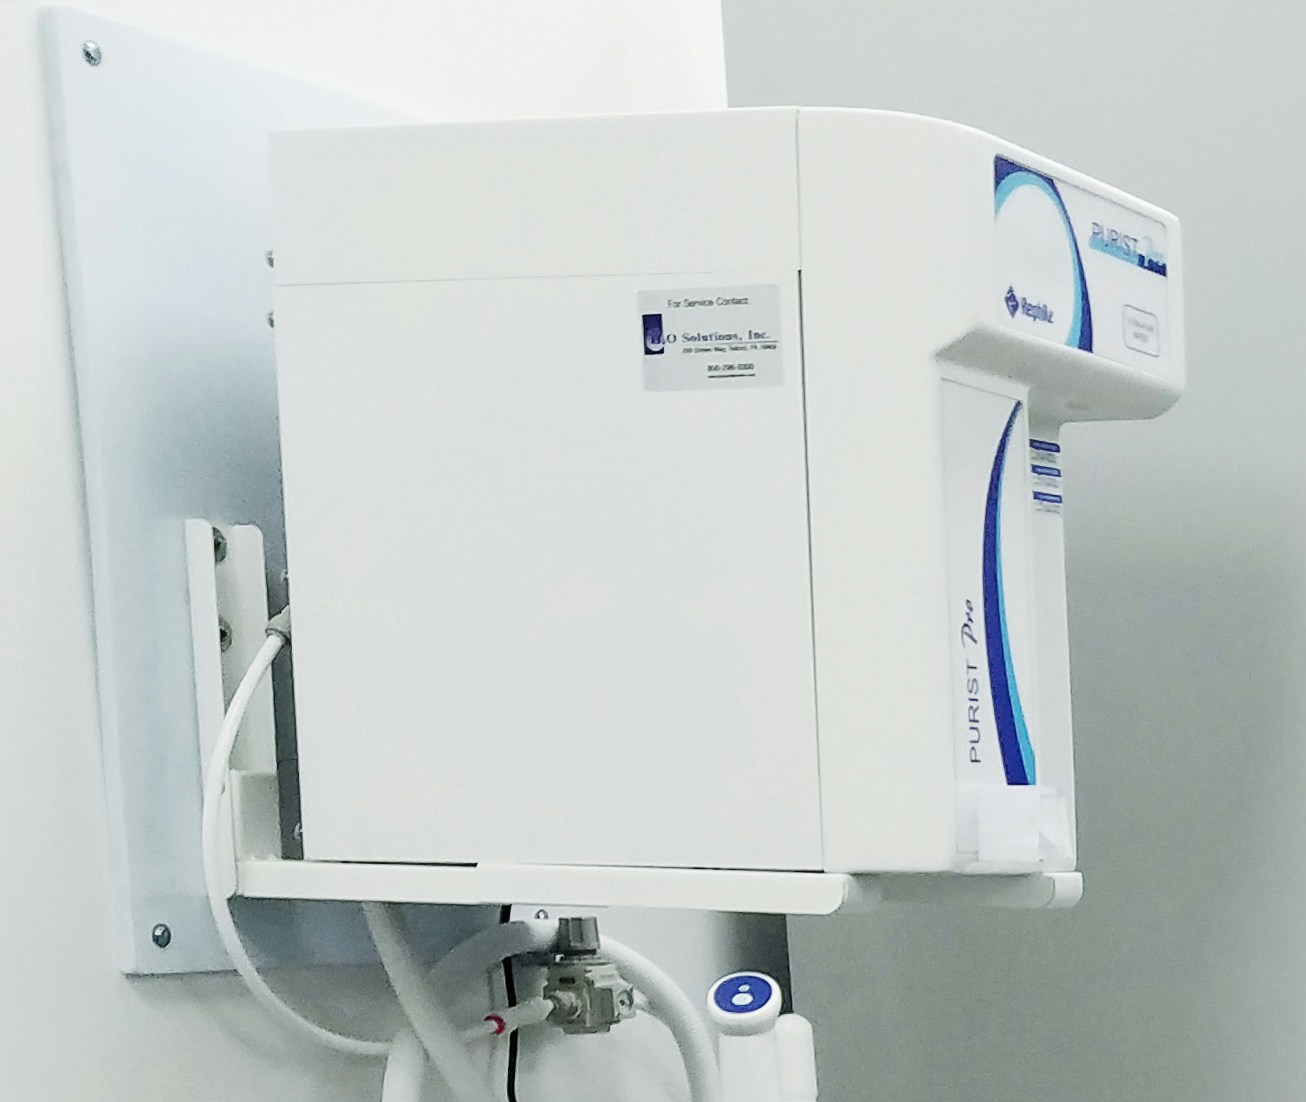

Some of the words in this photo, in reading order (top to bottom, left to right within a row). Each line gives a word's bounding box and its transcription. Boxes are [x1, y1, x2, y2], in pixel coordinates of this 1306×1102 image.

[667, 299, 681, 308] For
[684, 298, 714, 308] Service
[716, 296, 749, 306] Contact
[682, 332, 743, 343] Solutions,
[748, 330, 770, 340] Inc.
[966, 659, 981, 764] PURIST
